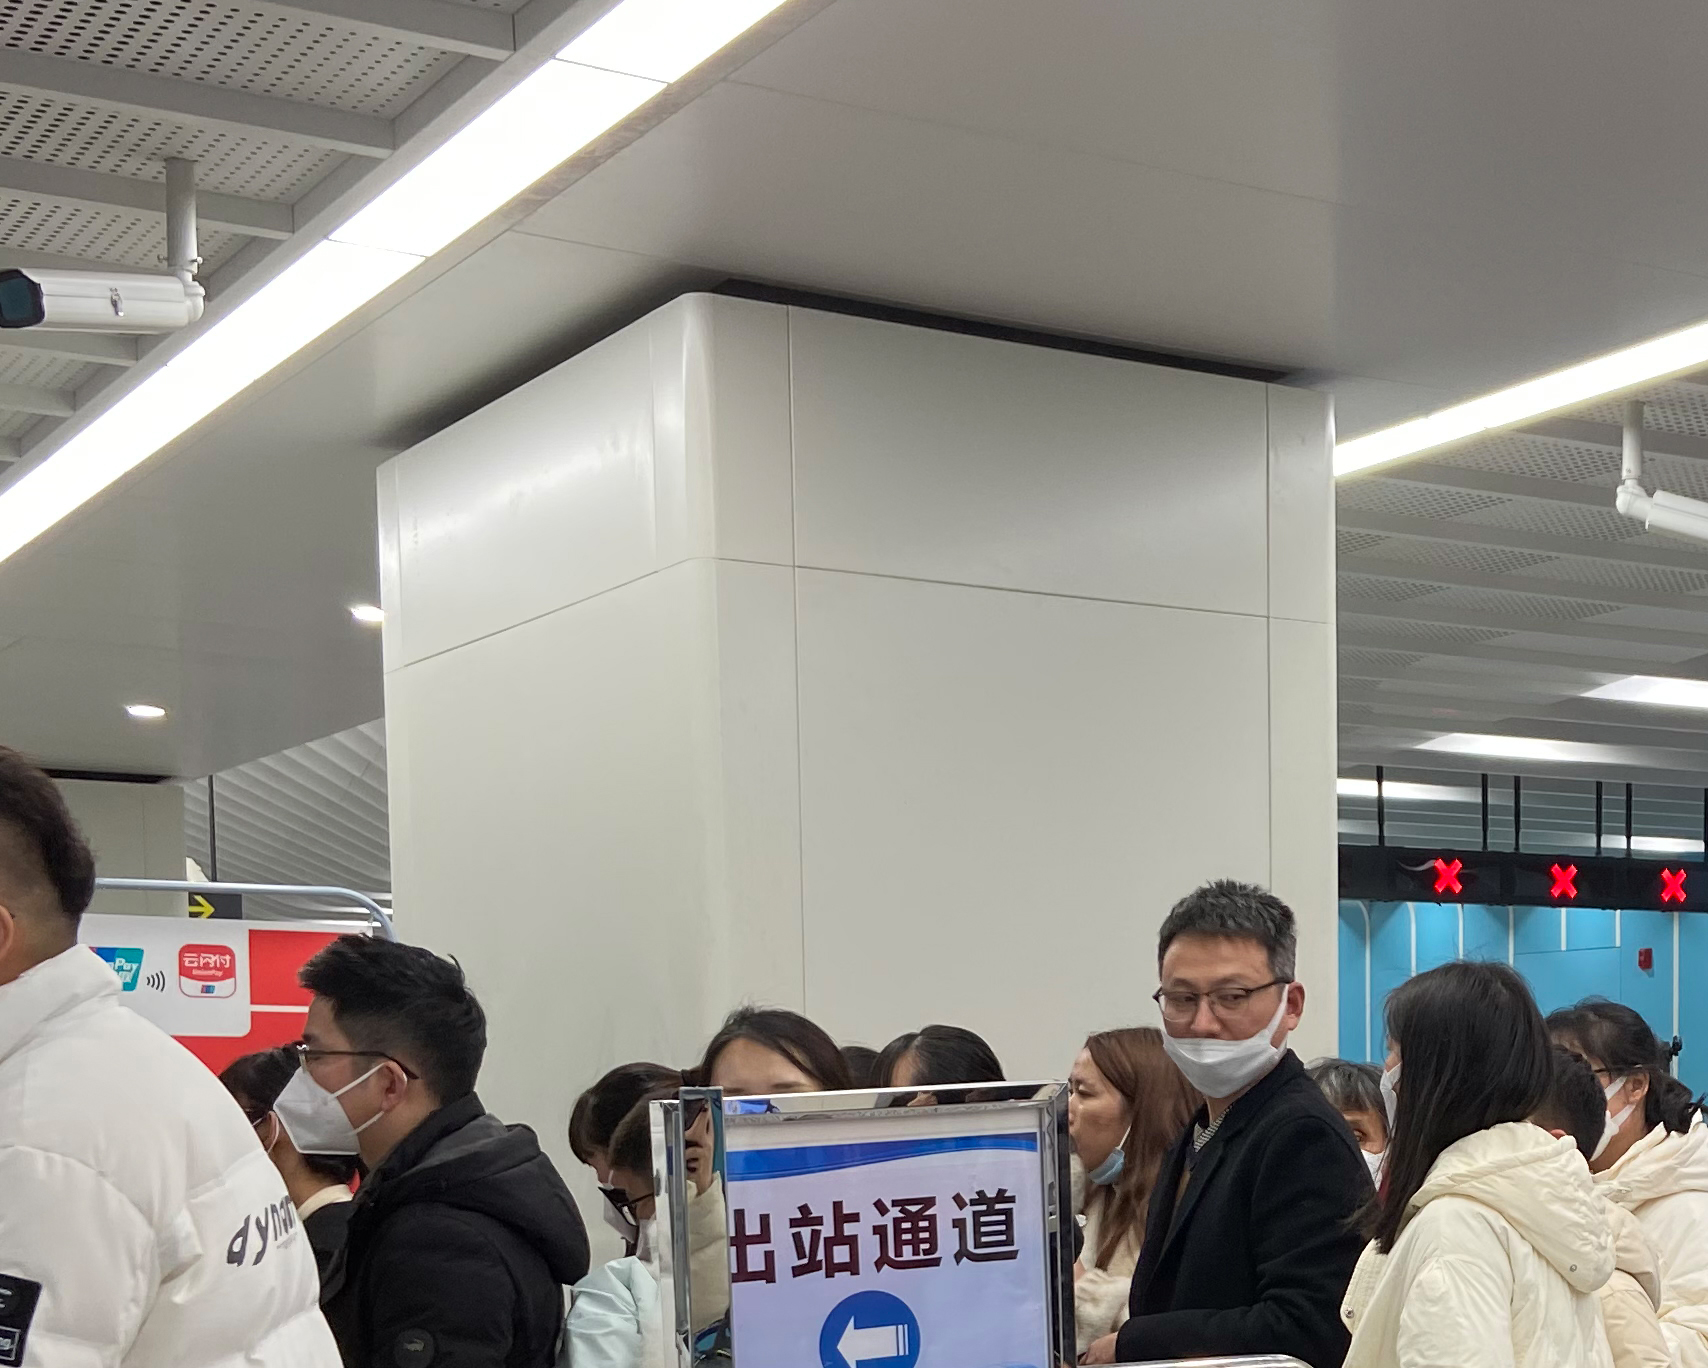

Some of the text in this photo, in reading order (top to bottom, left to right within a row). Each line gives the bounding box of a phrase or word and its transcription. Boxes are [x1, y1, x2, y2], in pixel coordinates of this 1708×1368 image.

[183, 952, 232, 968] 云闪付
[729, 1187, 1020, 1284] 出站通道
